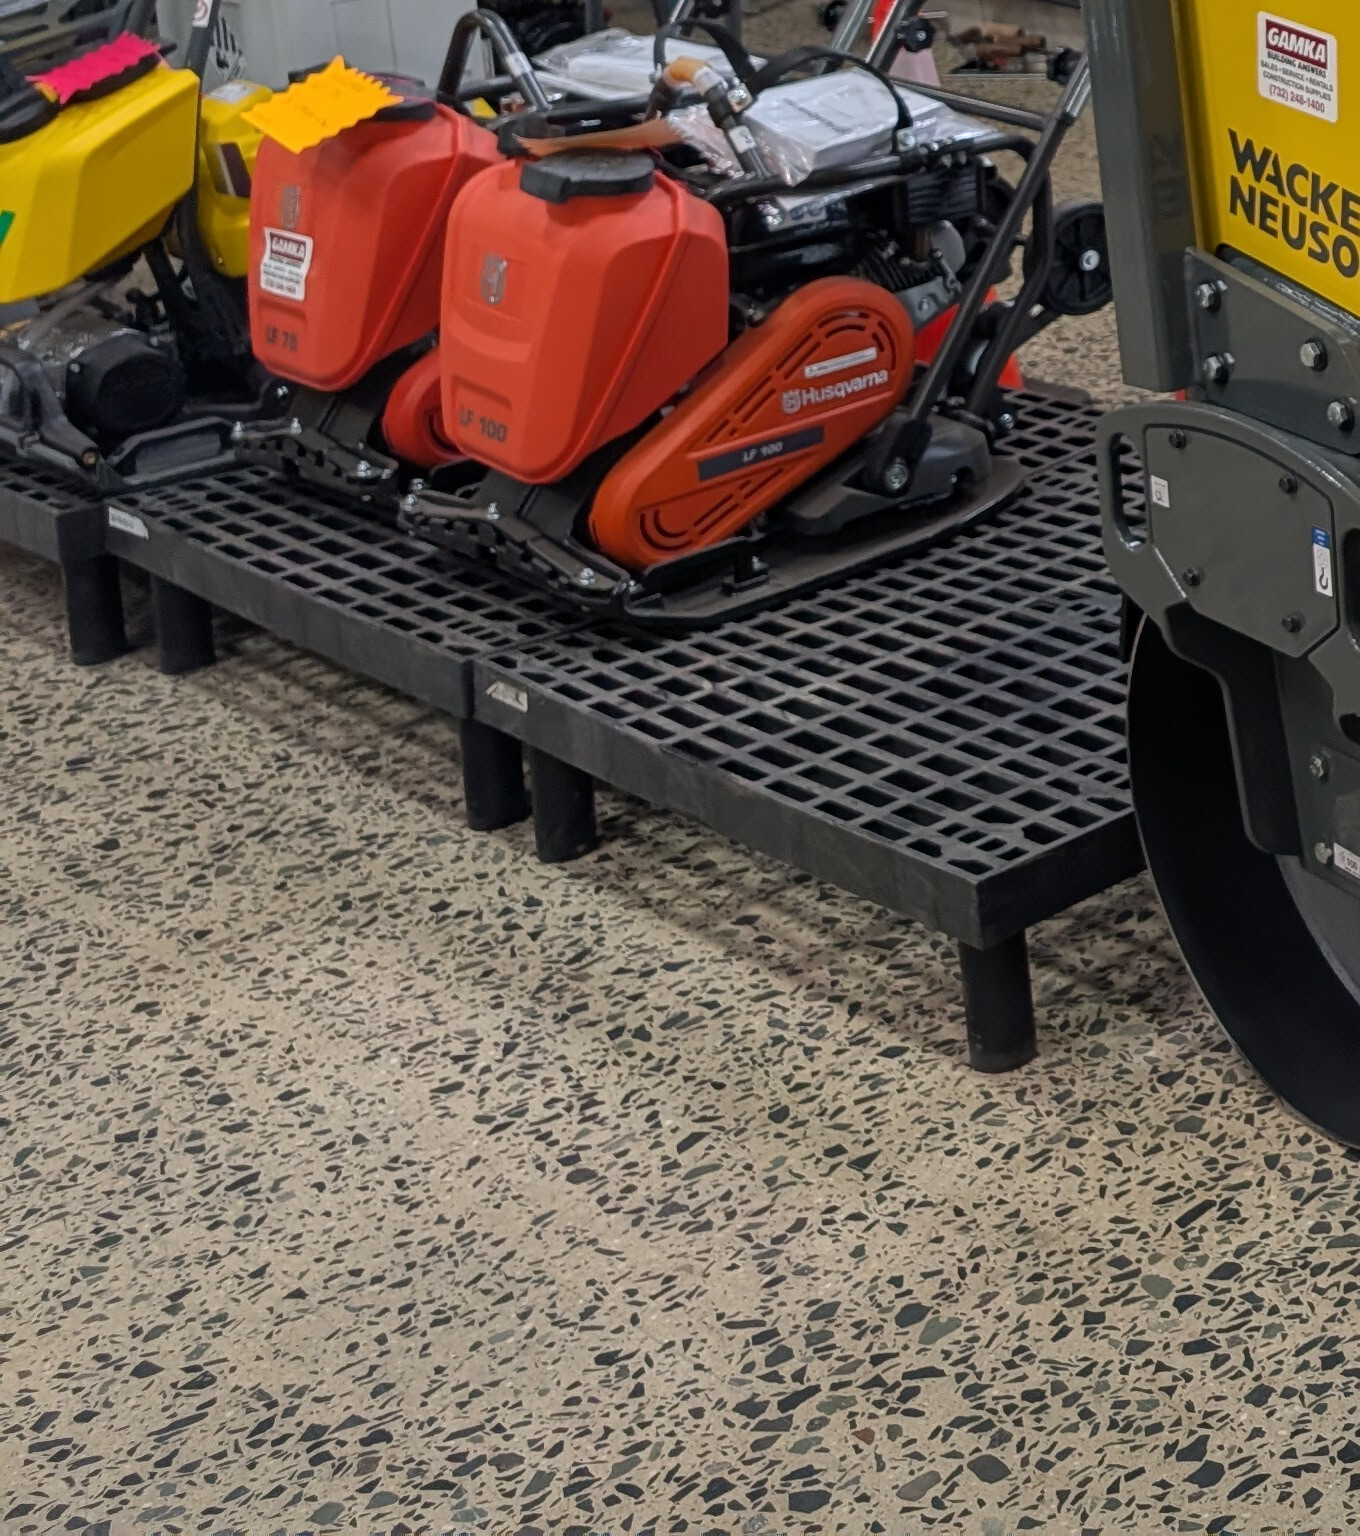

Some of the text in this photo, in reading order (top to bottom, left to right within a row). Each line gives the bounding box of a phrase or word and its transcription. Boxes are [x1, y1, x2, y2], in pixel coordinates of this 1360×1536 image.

[1267, 26, 1327, 64] GAMKA
[1269, 83, 1289, 102] (732)
[271, 235, 307, 259] GAMKA
[801, 369, 889, 407] Husqvarna
[457, 406, 508, 443] LF 100
